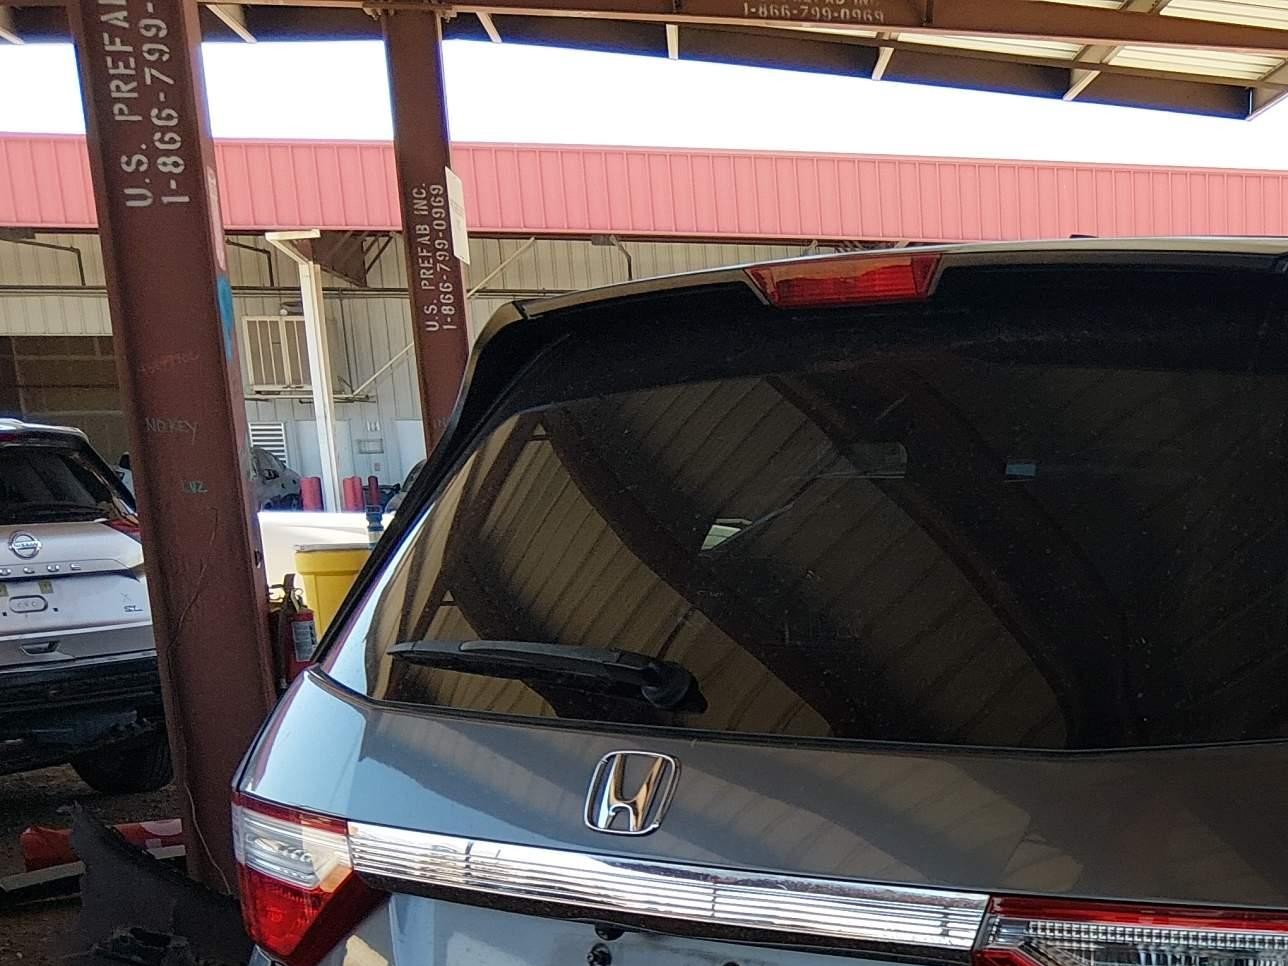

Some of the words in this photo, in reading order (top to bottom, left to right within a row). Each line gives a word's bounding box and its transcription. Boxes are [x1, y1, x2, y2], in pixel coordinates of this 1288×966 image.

[743, 3, 885, 23] 1-866-799-0969
[97, 0, 144, 121] PREFA
[139, 2, 190, 204] 1-866-799-
[121, 144, 154, 207] U.S.
[412, 182, 430, 216] INC.
[416, 224, 436, 290] PREFAB
[430, 184, 457, 330] 1-866-799-0969
[424, 299, 440, 331] U.S.
